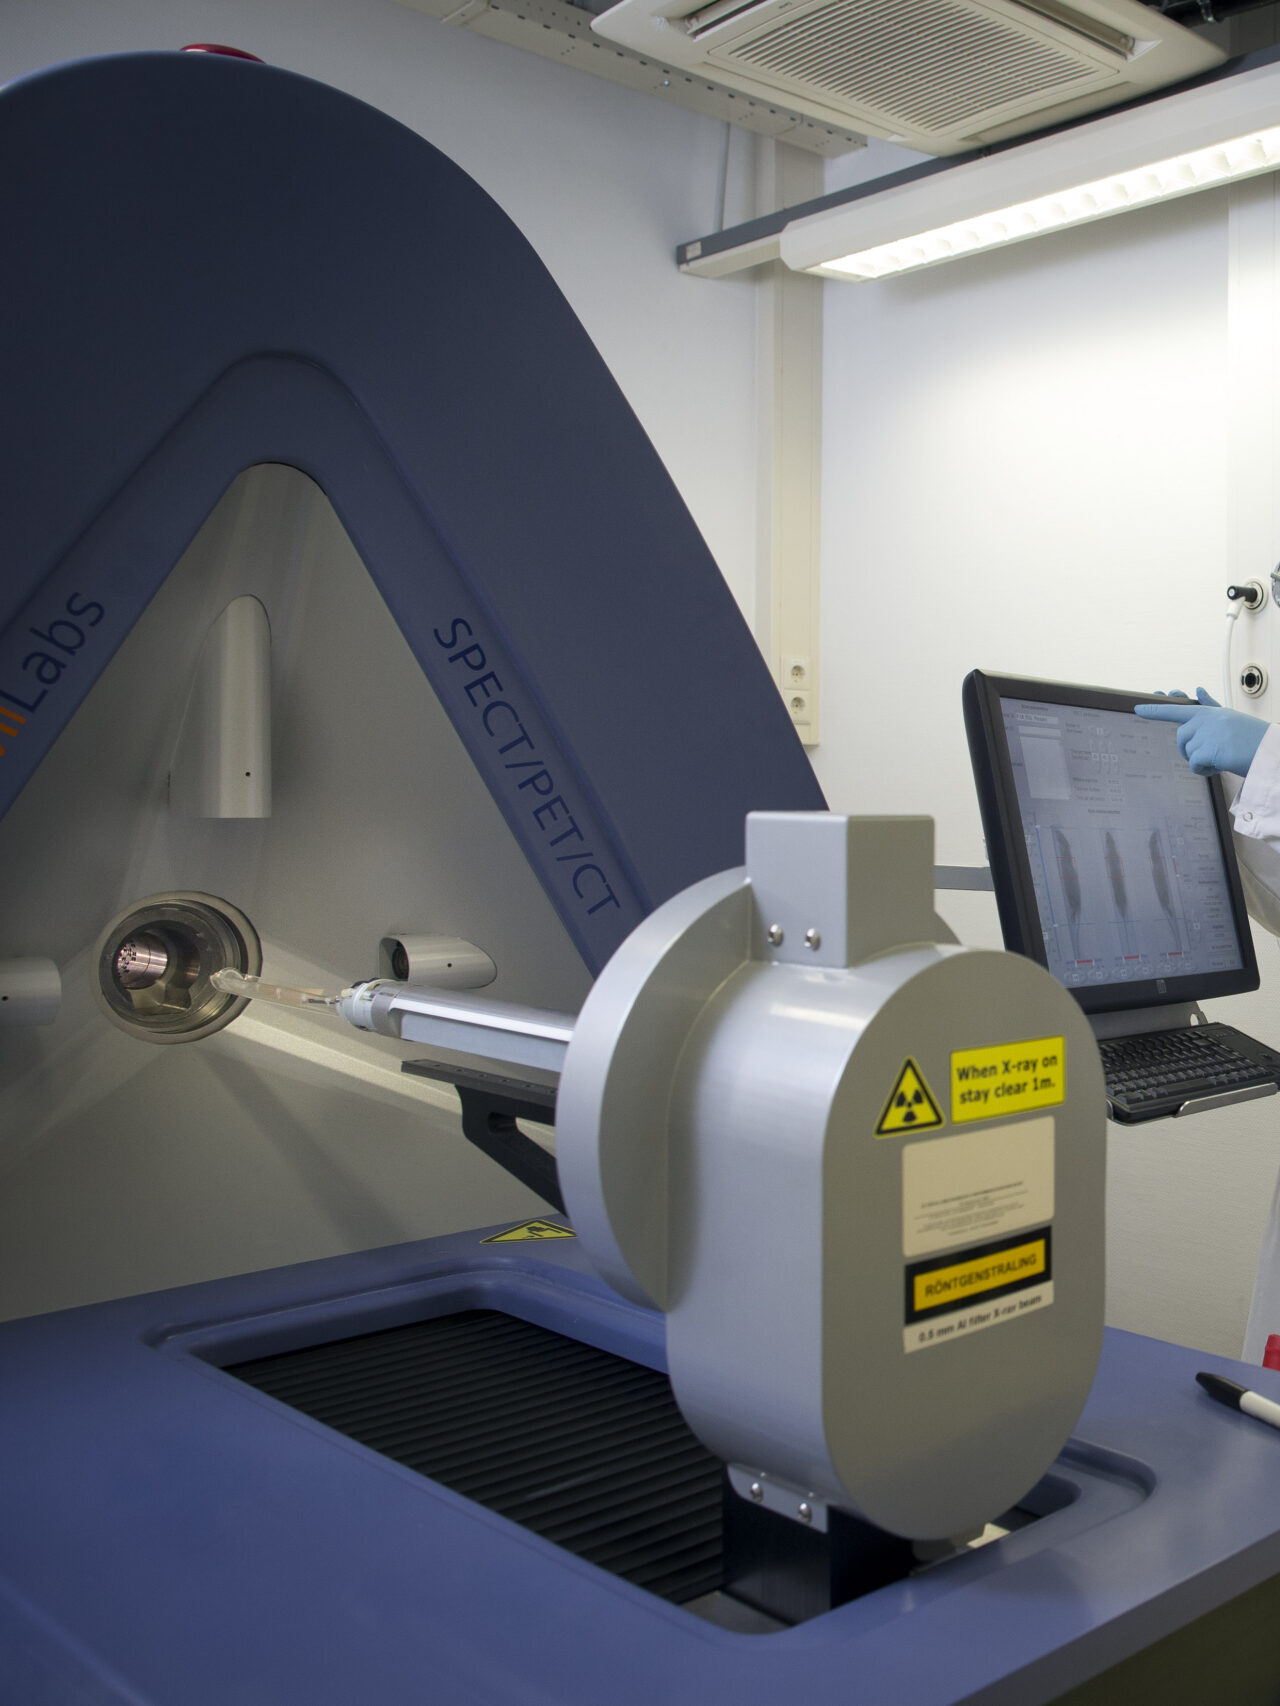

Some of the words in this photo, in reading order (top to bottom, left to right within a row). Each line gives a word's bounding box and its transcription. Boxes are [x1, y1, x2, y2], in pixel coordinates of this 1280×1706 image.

[433, 617, 621, 916] SPECT/PET/CT
[956, 1064, 998, 1082] When
[1002, 1059, 1038, 1074] X-ray
[1042, 1055, 1058, 1068] on
[960, 1088, 990, 1104] stay
[994, 1081, 1028, 1098] clear
[1033, 1077, 1056, 1092] 1m.
[925, 1253, 1037, 1297] RÖNTGENSTRALING
[936, 1325, 955, 1337] mm
[1018, 1295, 1042, 1309] beam
